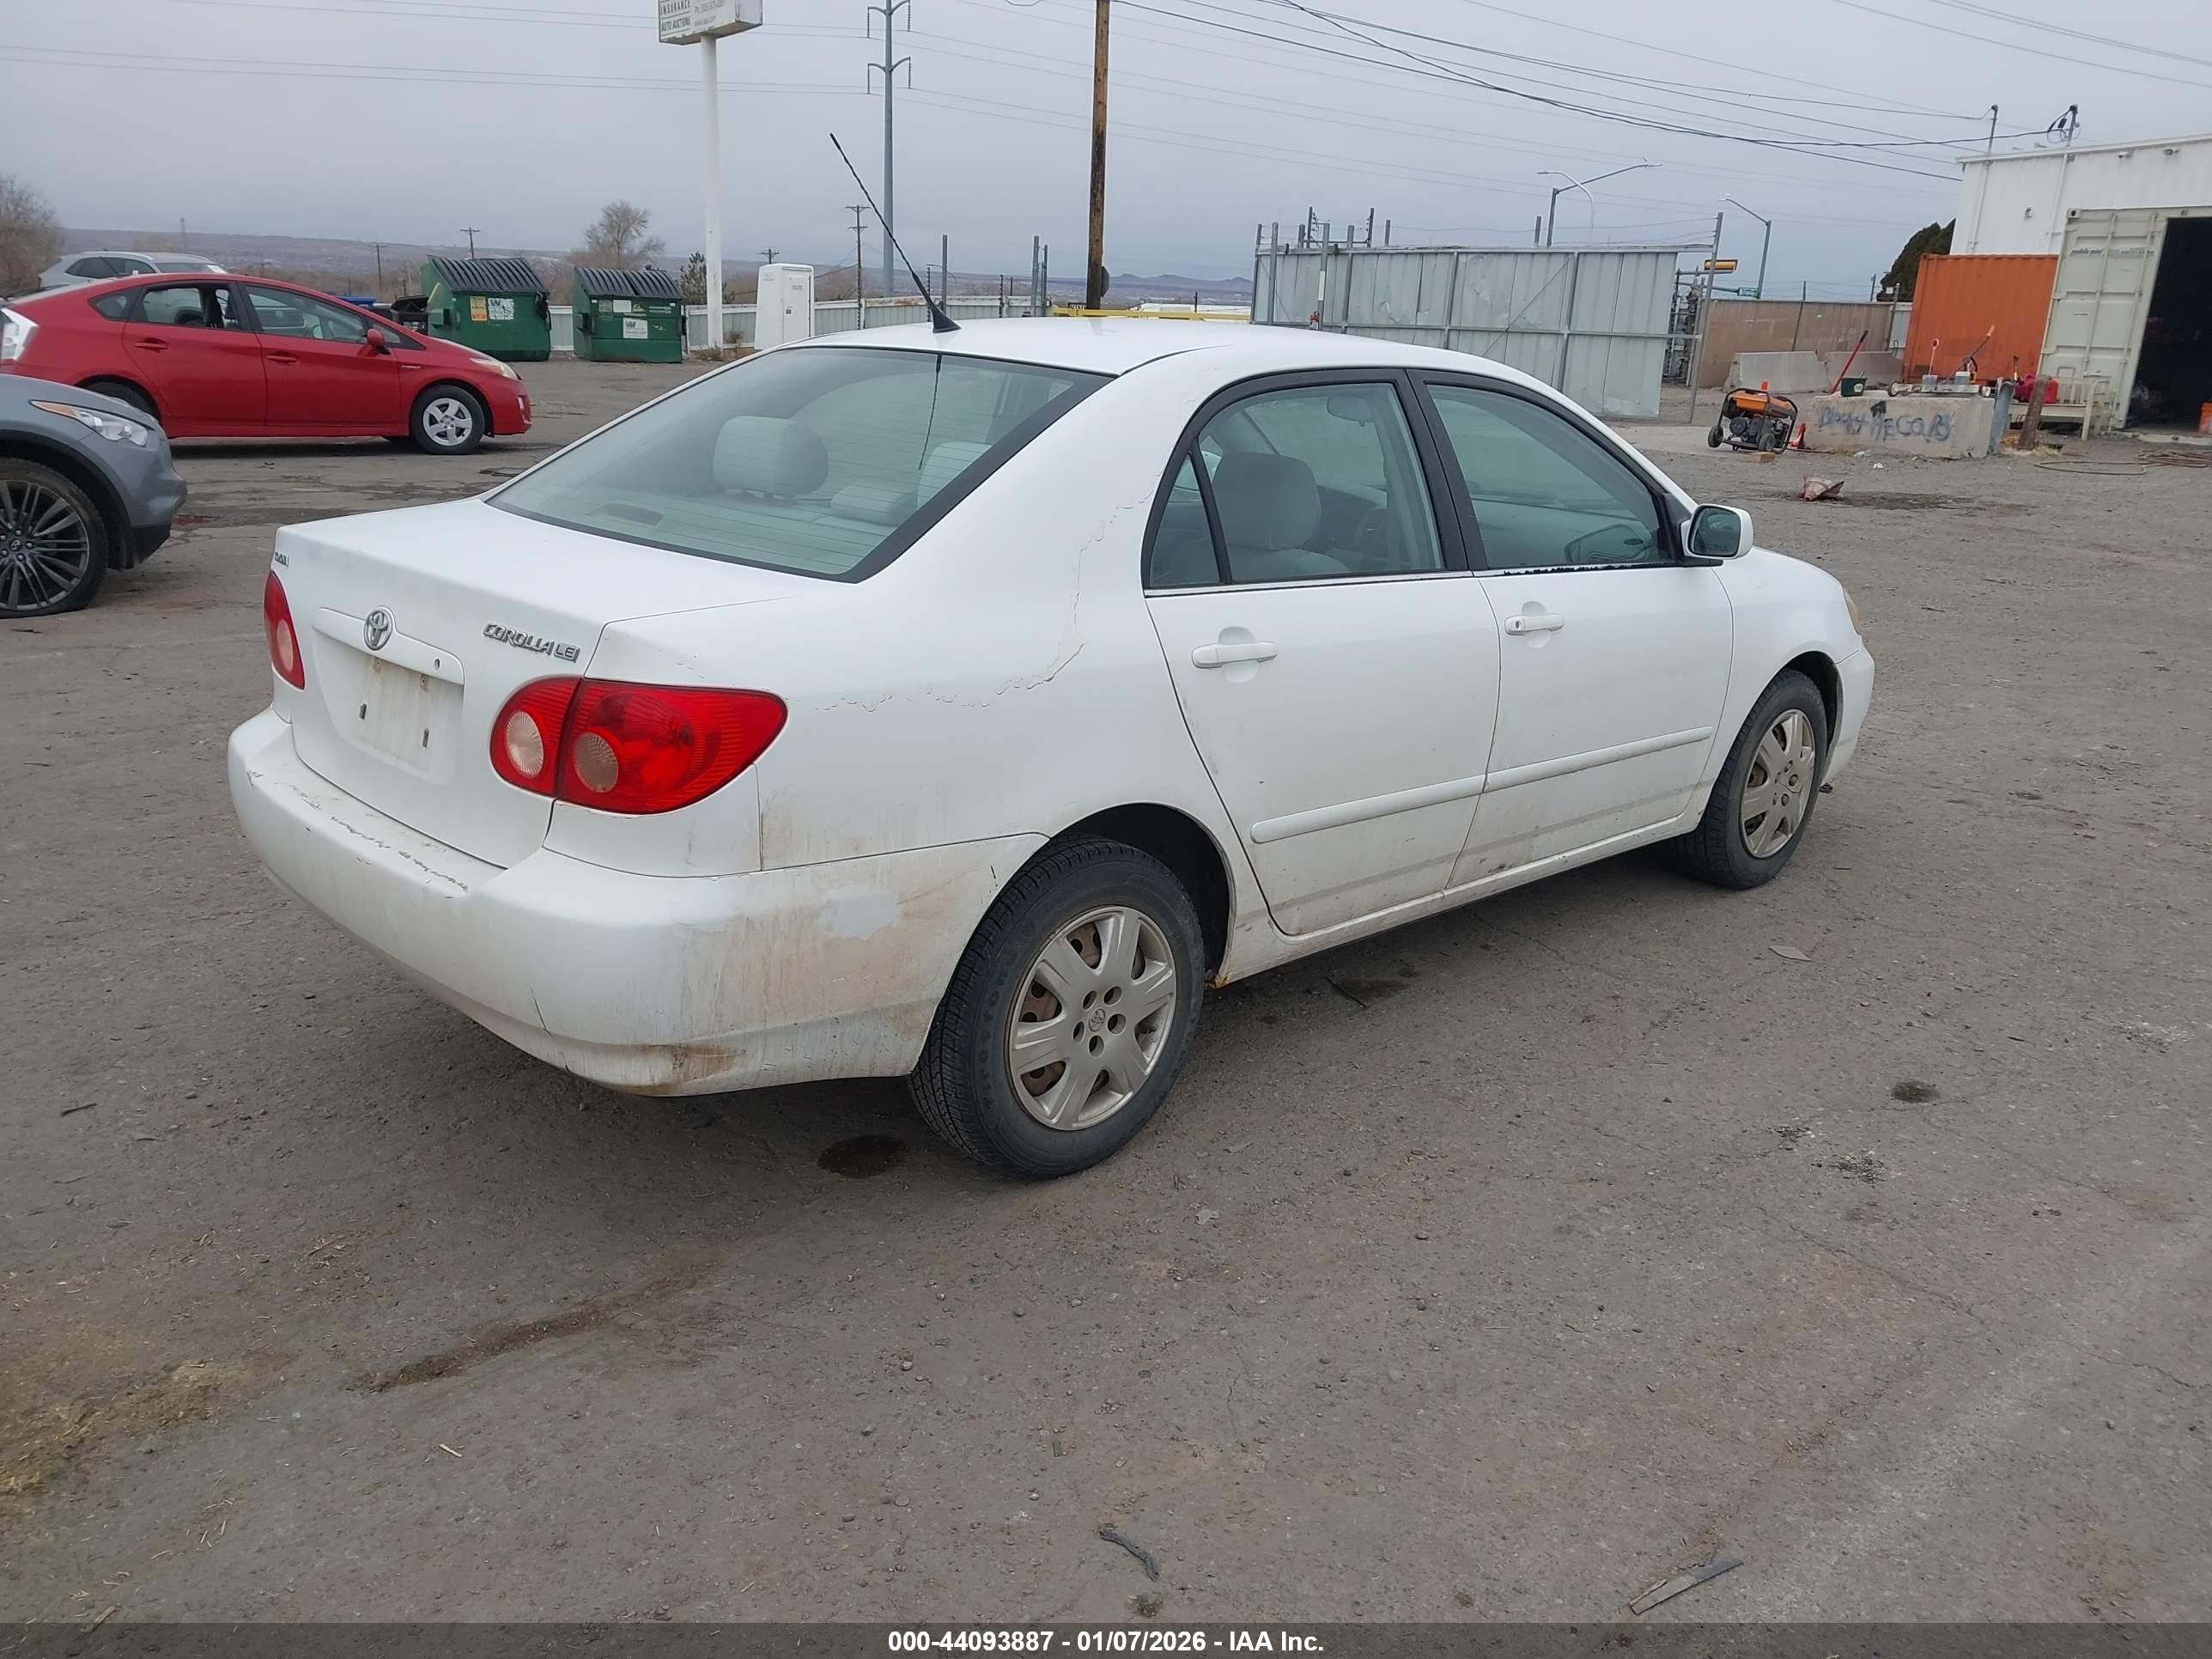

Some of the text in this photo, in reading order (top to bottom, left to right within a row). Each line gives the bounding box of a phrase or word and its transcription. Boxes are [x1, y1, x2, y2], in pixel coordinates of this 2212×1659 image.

[661, 0, 690, 15] INSURANCE
[483, 623, 578, 661] COROLLA LE
